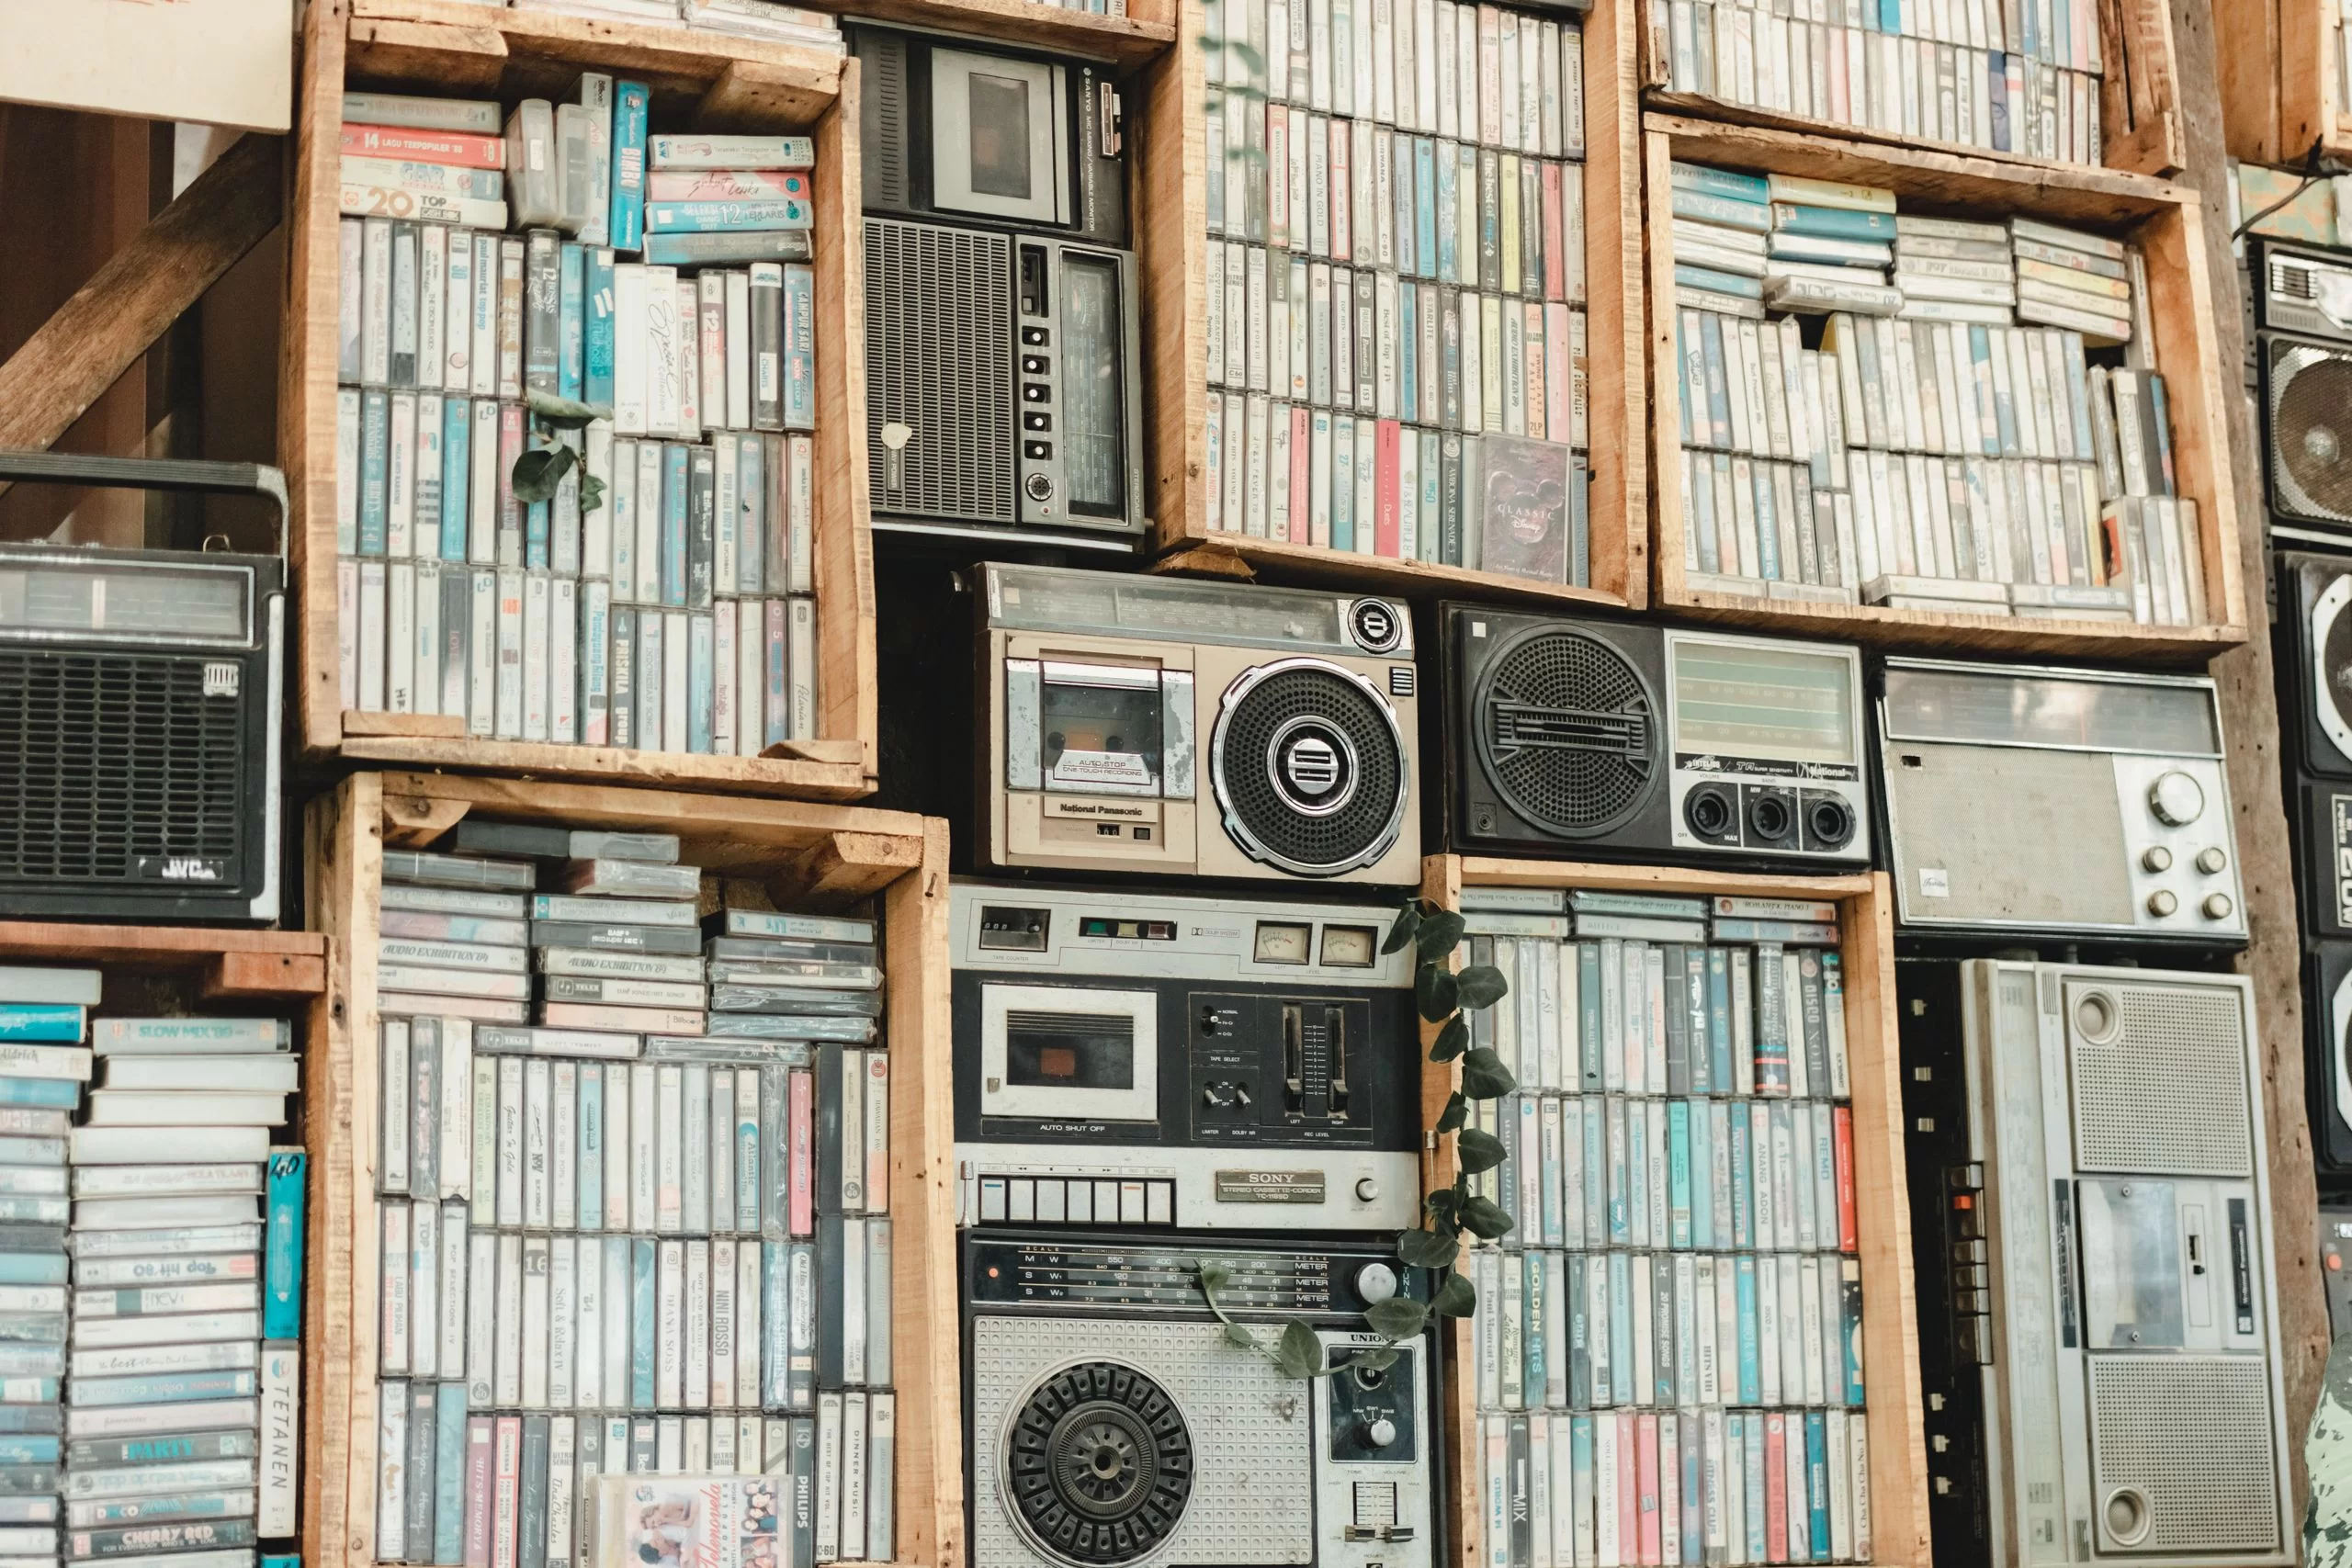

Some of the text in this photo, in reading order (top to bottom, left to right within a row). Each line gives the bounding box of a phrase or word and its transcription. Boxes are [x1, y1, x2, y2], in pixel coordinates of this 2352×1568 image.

[365, 132, 379, 149] 14
[382, 139, 401, 147] LAGU
[621, 148, 642, 187] BIMBO
[367, 186, 447, 217] 20 TOP
[1316, 154, 1325, 227] PIANO IN GOLD
[1485, 157, 1497, 220] the best of
[719, 204, 742, 226] 12
[451, 265, 469, 279] 30
[477, 239, 489, 331] paul mauriat top pop
[542, 267, 557, 280] 12
[703, 310, 718, 332] 12
[797, 291, 809, 354] CAMPUR SARI
[1426, 296, 1434, 340] STARLITE
[592, 321, 604, 367] Michael
[603, 322, 613, 366] George
[1384, 504, 1393, 526] Duets
[615, 639, 629, 744] PRISKILA group
[1810, 766, 1846, 777] National
[1060, 803, 1142, 817] National Panasonic
[163, 860, 204, 879] JVC
[383, 945, 415, 954] AUDIO
[569, 957, 599, 968] AUDIO
[1805, 986, 1820, 1022] DISCO
[139, 1026, 178, 1038] SLOW
[504, 1106, 517, 1174] Guitar Gold
[1819, 1137, 1830, 1179] REMO
[747, 1143, 756, 1186] Atlantic
[1249, 1173, 1295, 1183] SONY
[1653, 1156, 1661, 1186] DISCO
[1758, 1143, 1768, 1182] ANANG
[419, 1221, 430, 1247] TOP
[554, 1288, 566, 1358] Soft Relax
[665, 1294, 675, 1334] DIANA
[715, 1291, 729, 1356] NINI ROSSO
[1531, 1262, 1543, 1373] GOLDEN HITS
[1703, 1346, 1713, 1371] HITS
[128, 1440, 195, 1461] PARTY
[271, 1384, 290, 1489] TETANEN
[853, 1430, 861, 1476] DINNER
[797, 1475, 808, 1529] PHILIPS
[1513, 1495, 1526, 1522] MIX
[122, 1527, 213, 1544] CHERRY RED
